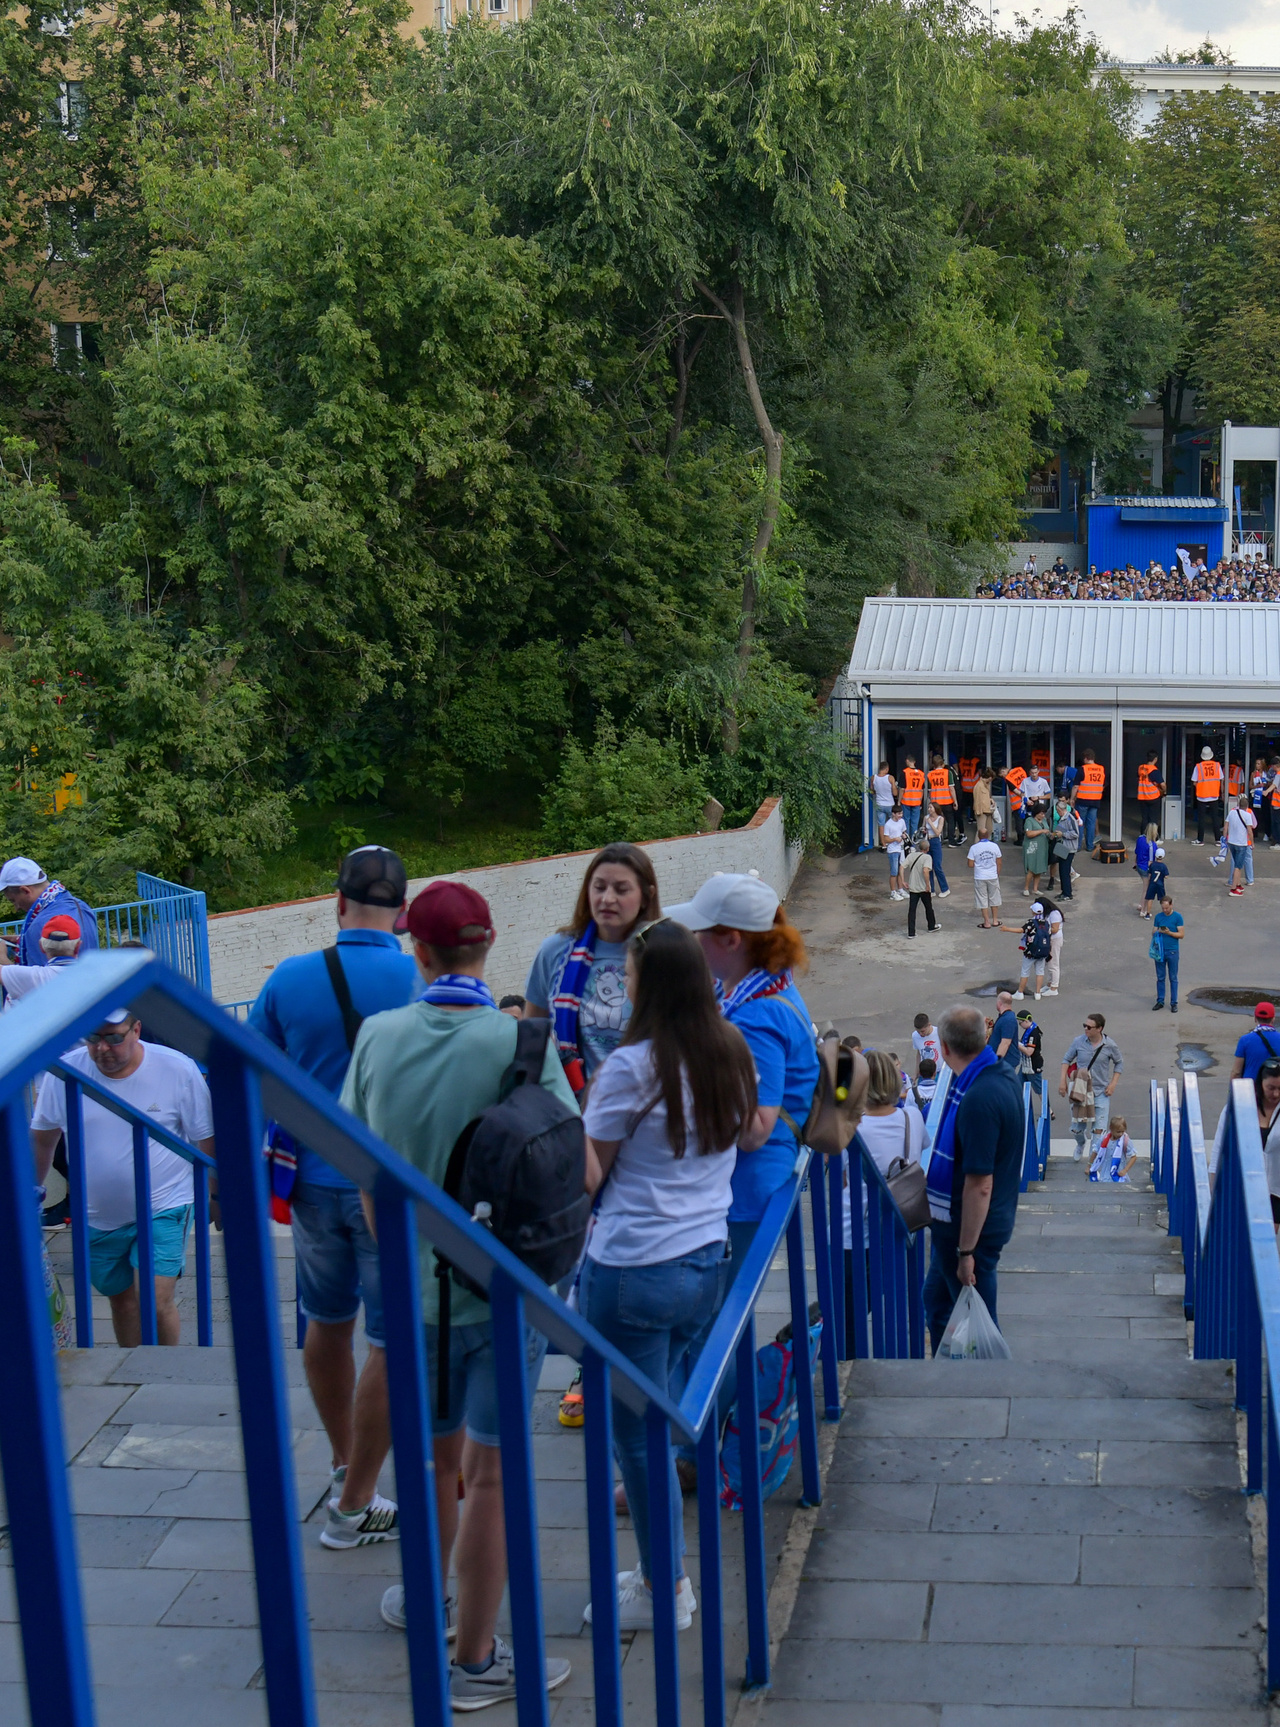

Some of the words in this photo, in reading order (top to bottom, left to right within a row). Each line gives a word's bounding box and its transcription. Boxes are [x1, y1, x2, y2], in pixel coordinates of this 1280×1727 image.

[911, 777, 921, 789] 67
[931, 777, 945, 787] 148
[1089, 773, 1102, 783] 152
[1153, 870, 1161, 882] 7
